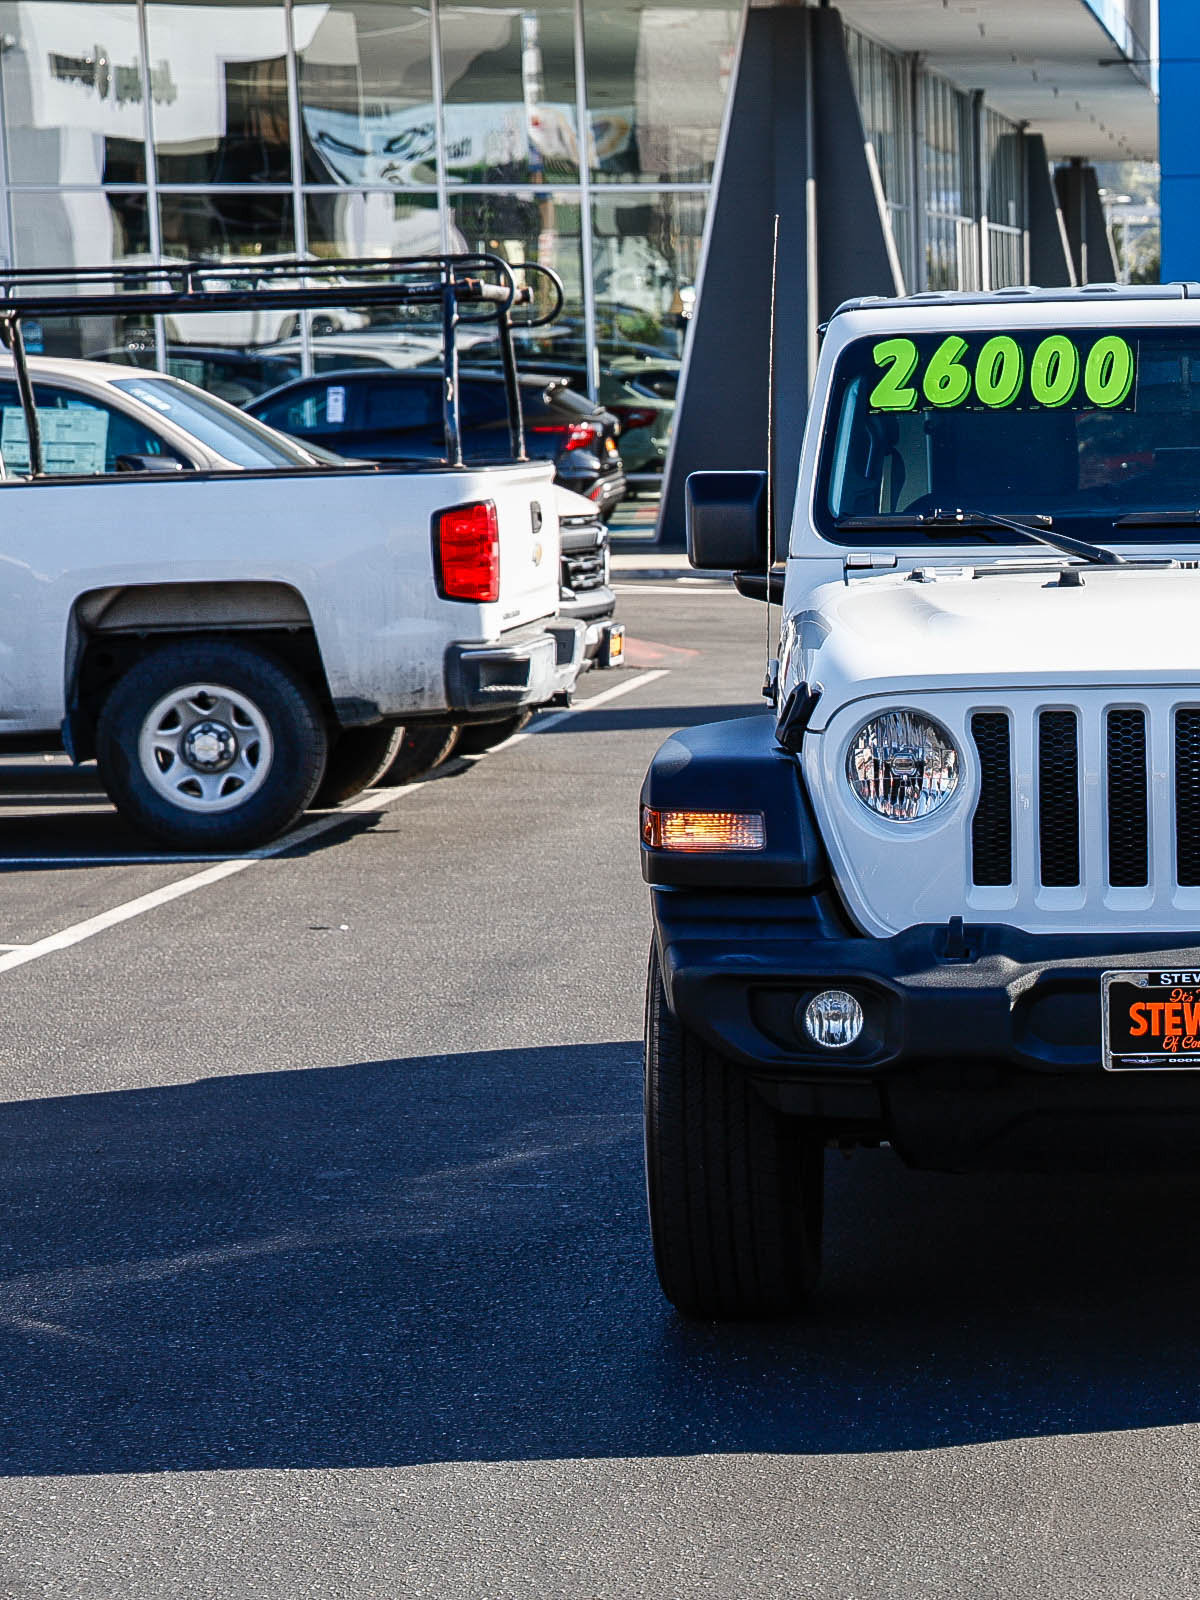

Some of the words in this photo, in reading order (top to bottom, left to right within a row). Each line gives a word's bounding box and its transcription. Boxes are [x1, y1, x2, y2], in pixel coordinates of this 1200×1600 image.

[869, 335, 1134, 411] 26000
[1169, 988, 1194, 1003] It's
[1162, 1035, 1179, 1052] Of
